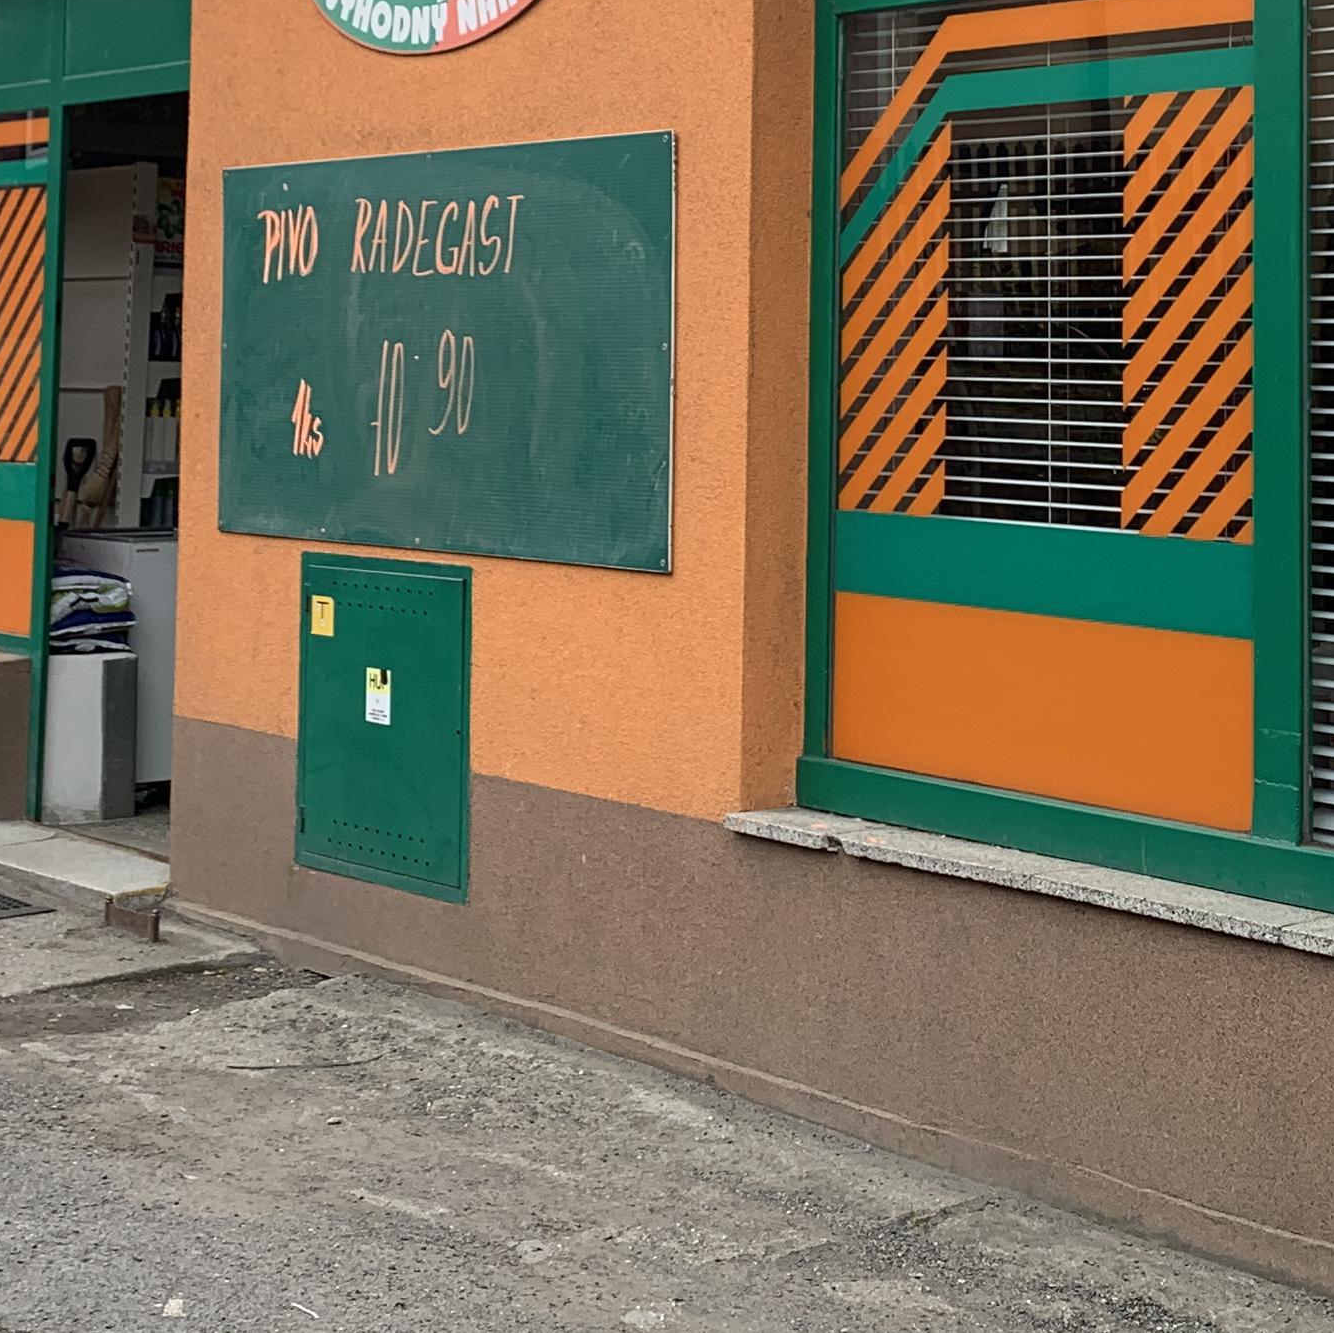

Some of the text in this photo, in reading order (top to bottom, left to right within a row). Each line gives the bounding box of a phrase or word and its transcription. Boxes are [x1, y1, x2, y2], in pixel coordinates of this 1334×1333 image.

[258, 194, 524, 284] PIVO RADEGAST
[371, 340, 404, 476] 10
[429, 329, 475, 435] 90
